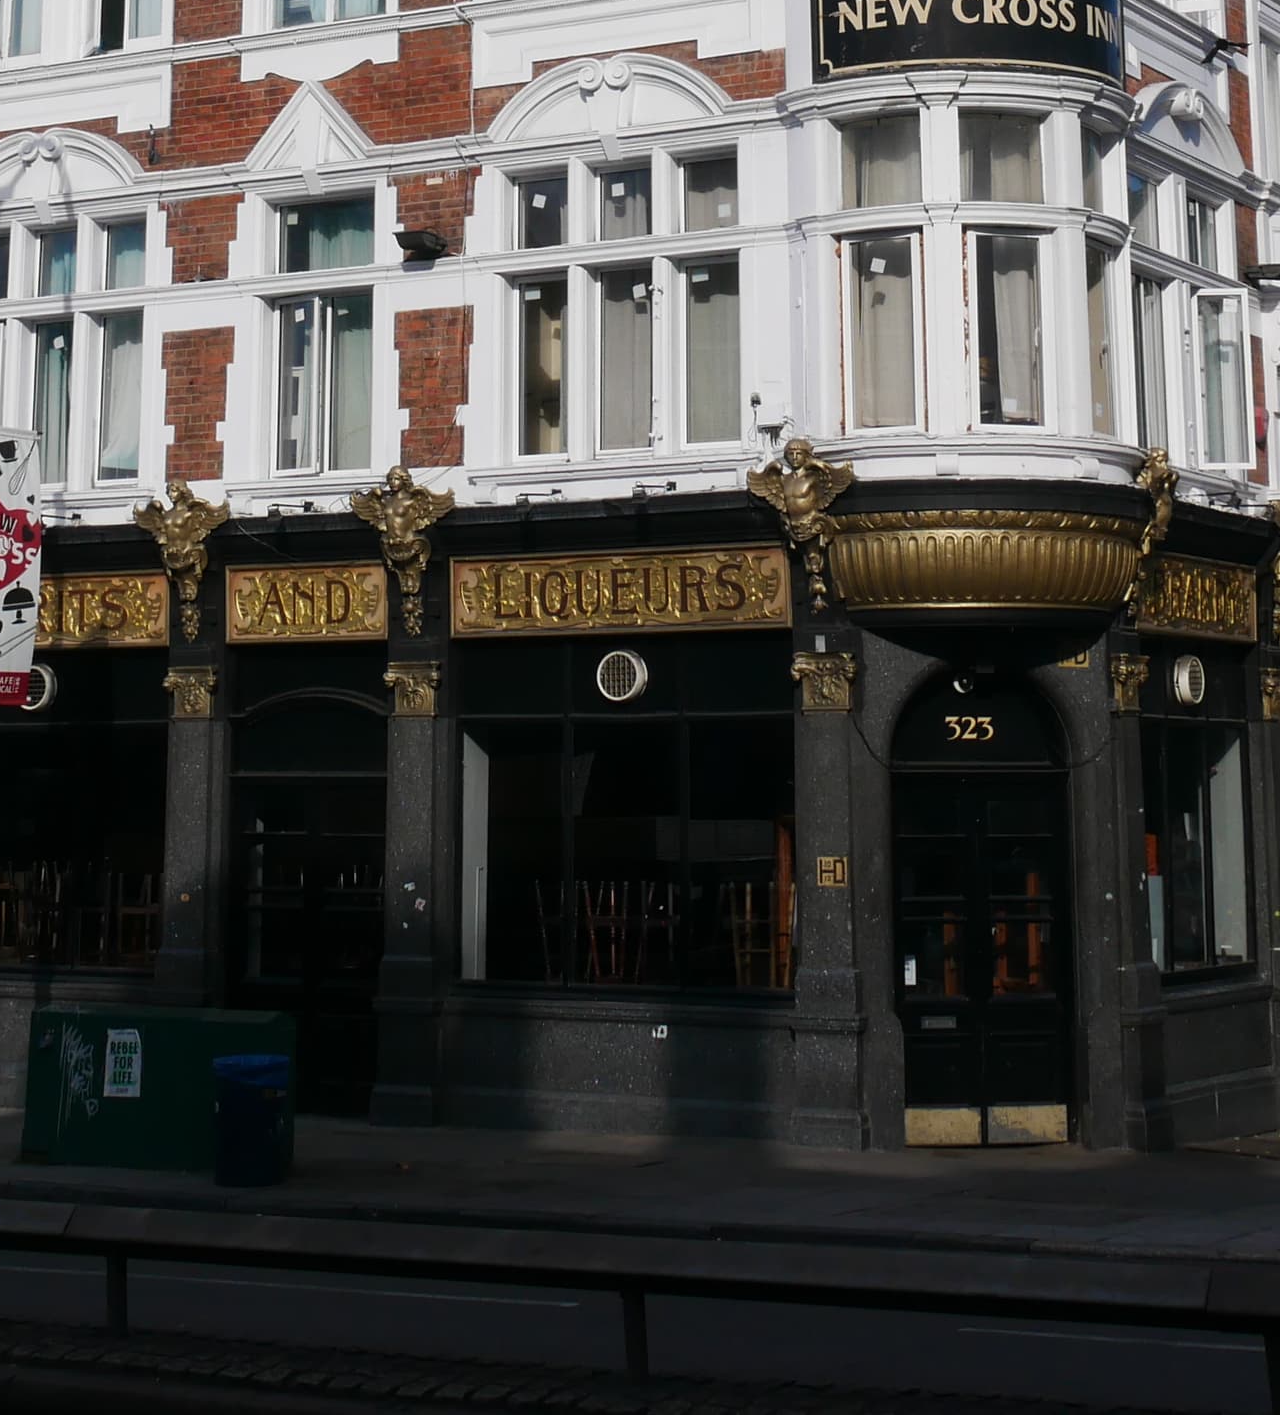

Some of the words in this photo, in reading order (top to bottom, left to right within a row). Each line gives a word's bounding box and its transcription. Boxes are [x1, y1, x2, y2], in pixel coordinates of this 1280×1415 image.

[493, 562, 749, 621] LIQUEURS
[258, 578, 353, 628] AND
[945, 716, 995, 741] 323
[110, 1042, 138, 1054] REBEL
[114, 1056, 133, 1069] FOR
[113, 1071, 132, 1084] LIFE
